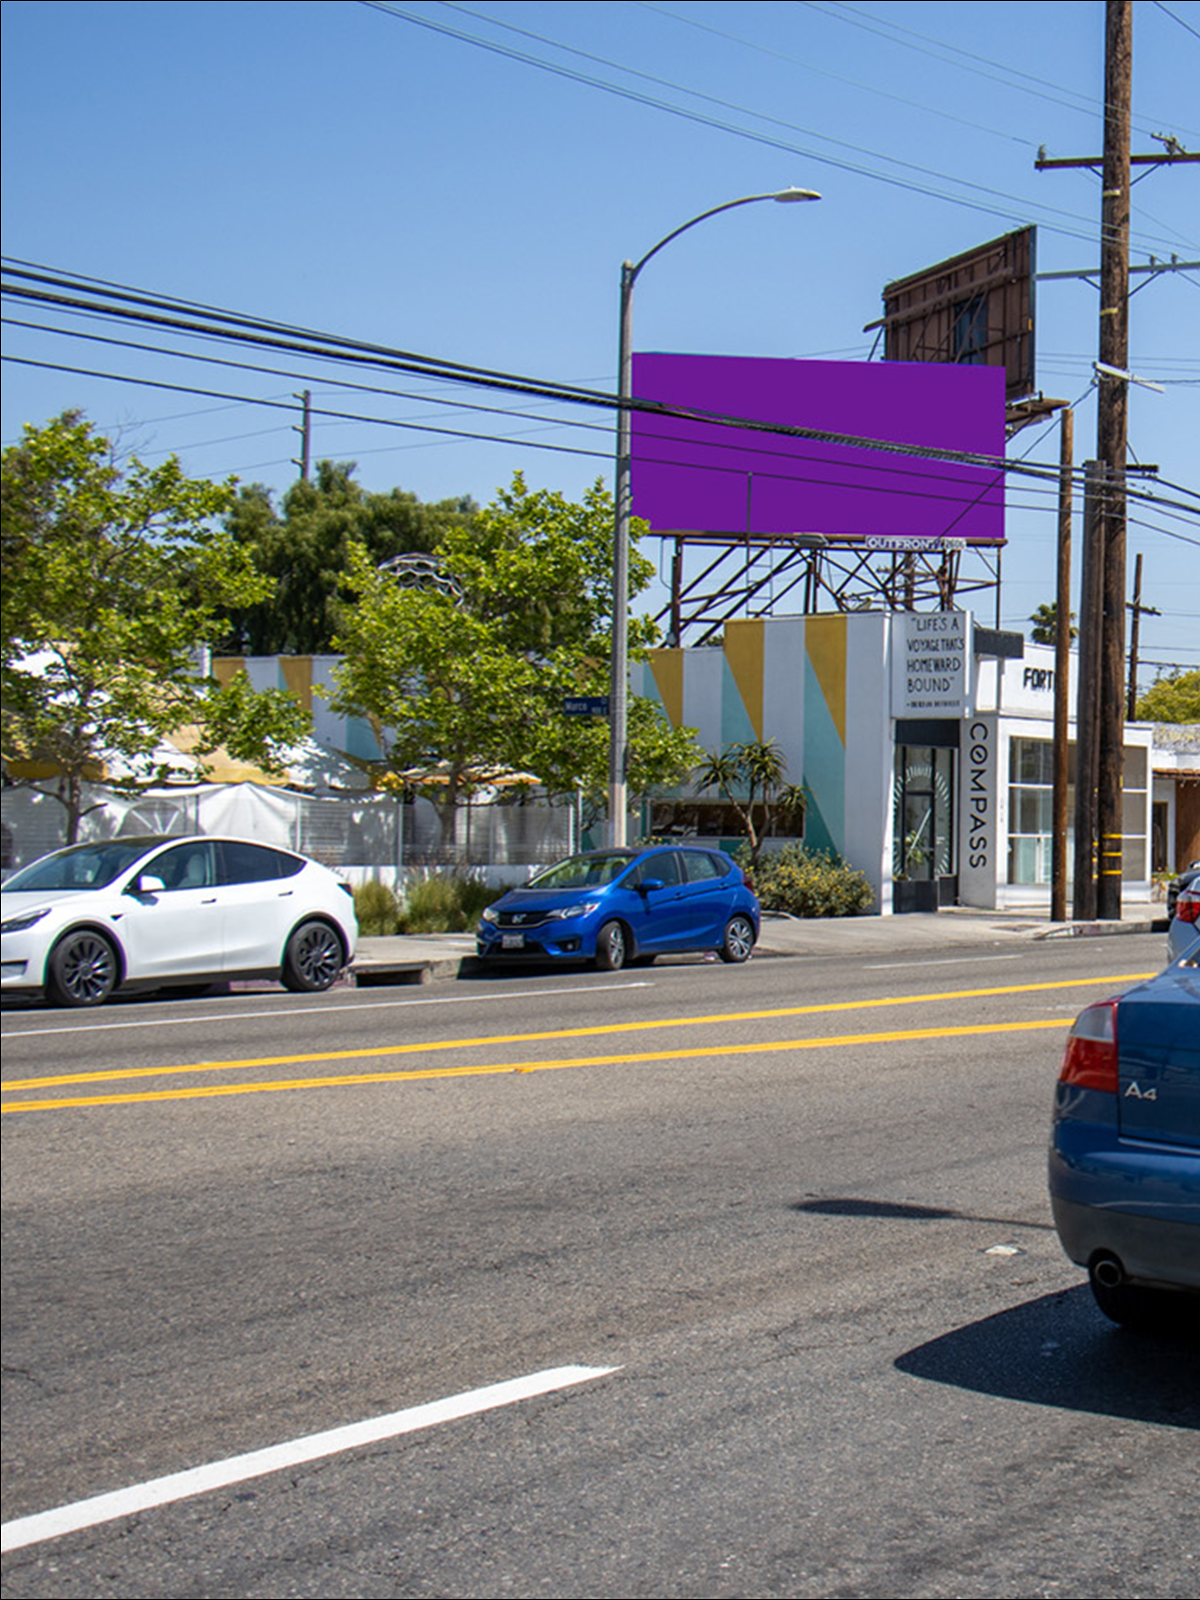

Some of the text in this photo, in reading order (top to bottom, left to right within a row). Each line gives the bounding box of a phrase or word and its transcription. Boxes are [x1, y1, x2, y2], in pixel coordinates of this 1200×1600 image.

[951, 617, 960, 631] A
[907, 638, 939, 653] VOYAGE
[907, 656, 961, 672] HOMEWARD
[907, 676, 955, 693] BOUND"
[1124, 1081, 1157, 1100] A4
